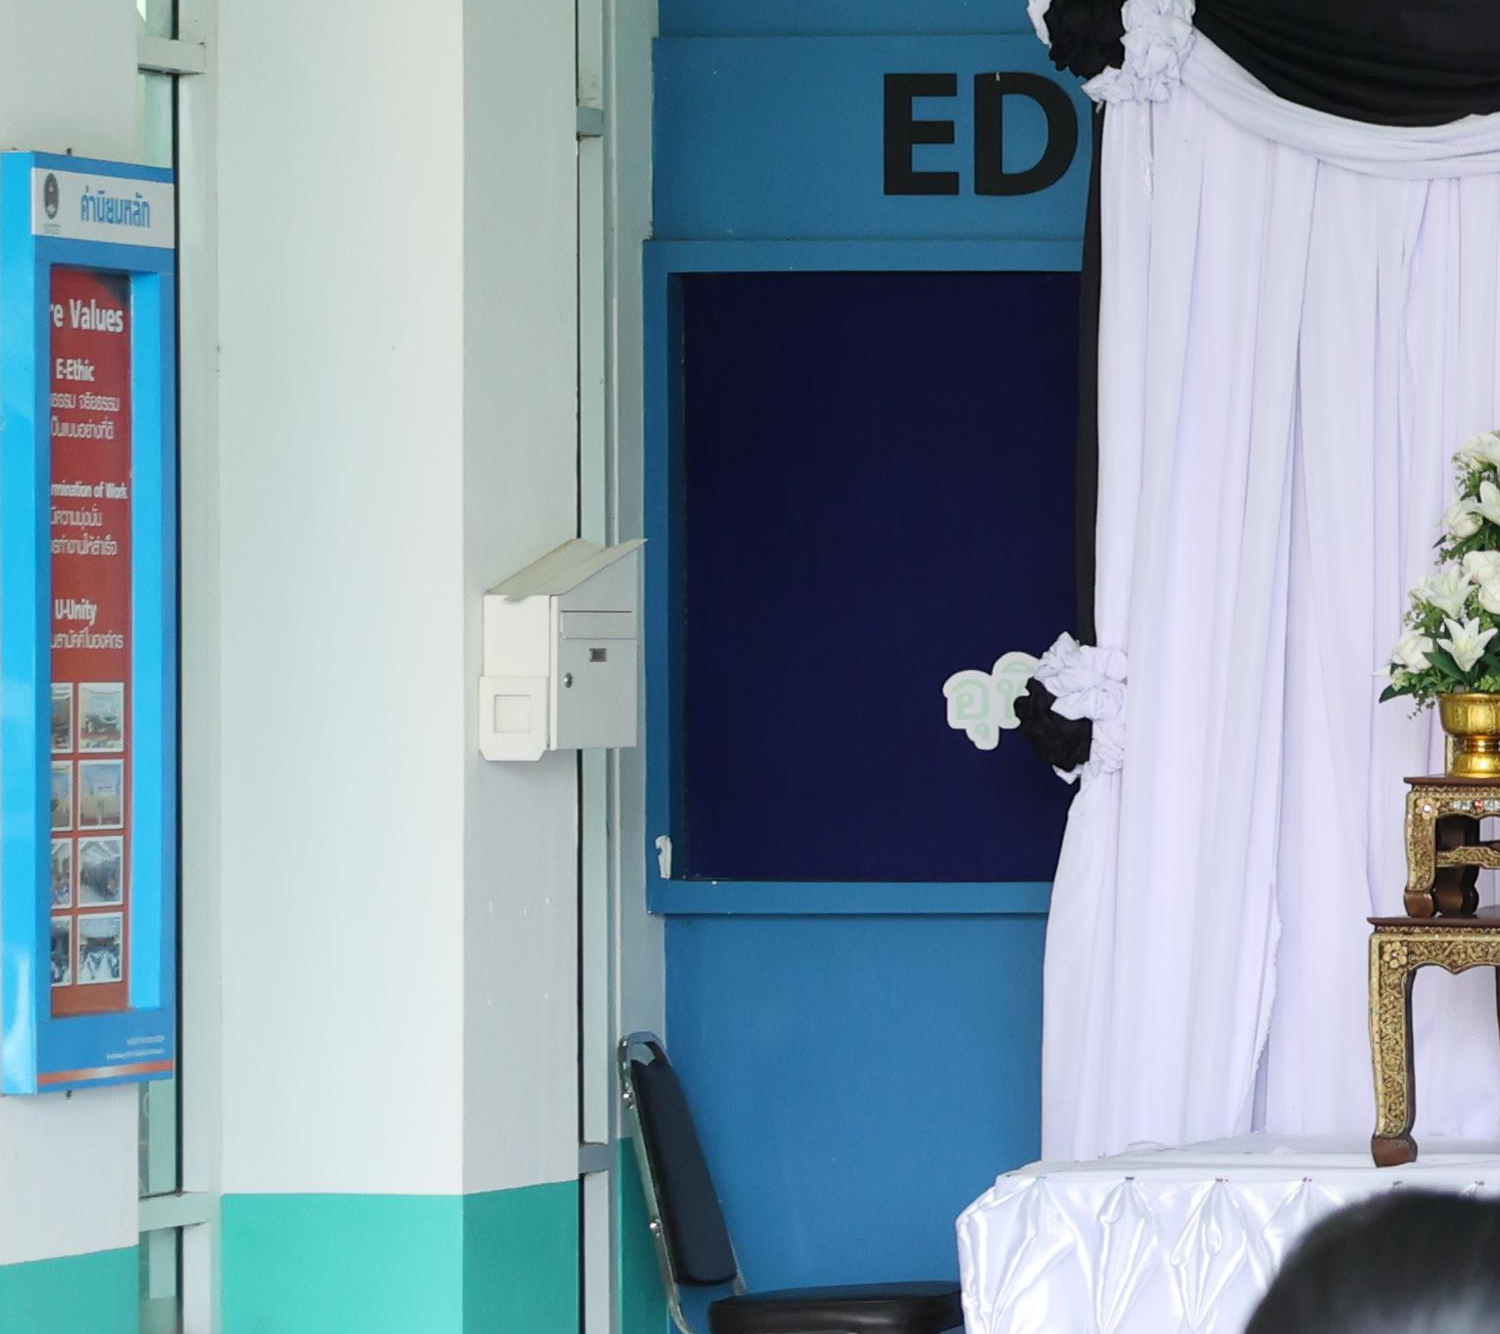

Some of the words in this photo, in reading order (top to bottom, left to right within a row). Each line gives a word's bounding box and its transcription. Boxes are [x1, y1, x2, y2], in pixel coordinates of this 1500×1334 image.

[881, 71, 1079, 197] ED
[79, 184, 151, 229] ค่านิยมหลัก
[69, 298, 124, 333] Values
[56, 357, 96, 383] E-Ethic
[54, 598, 98, 627] U-Unity
